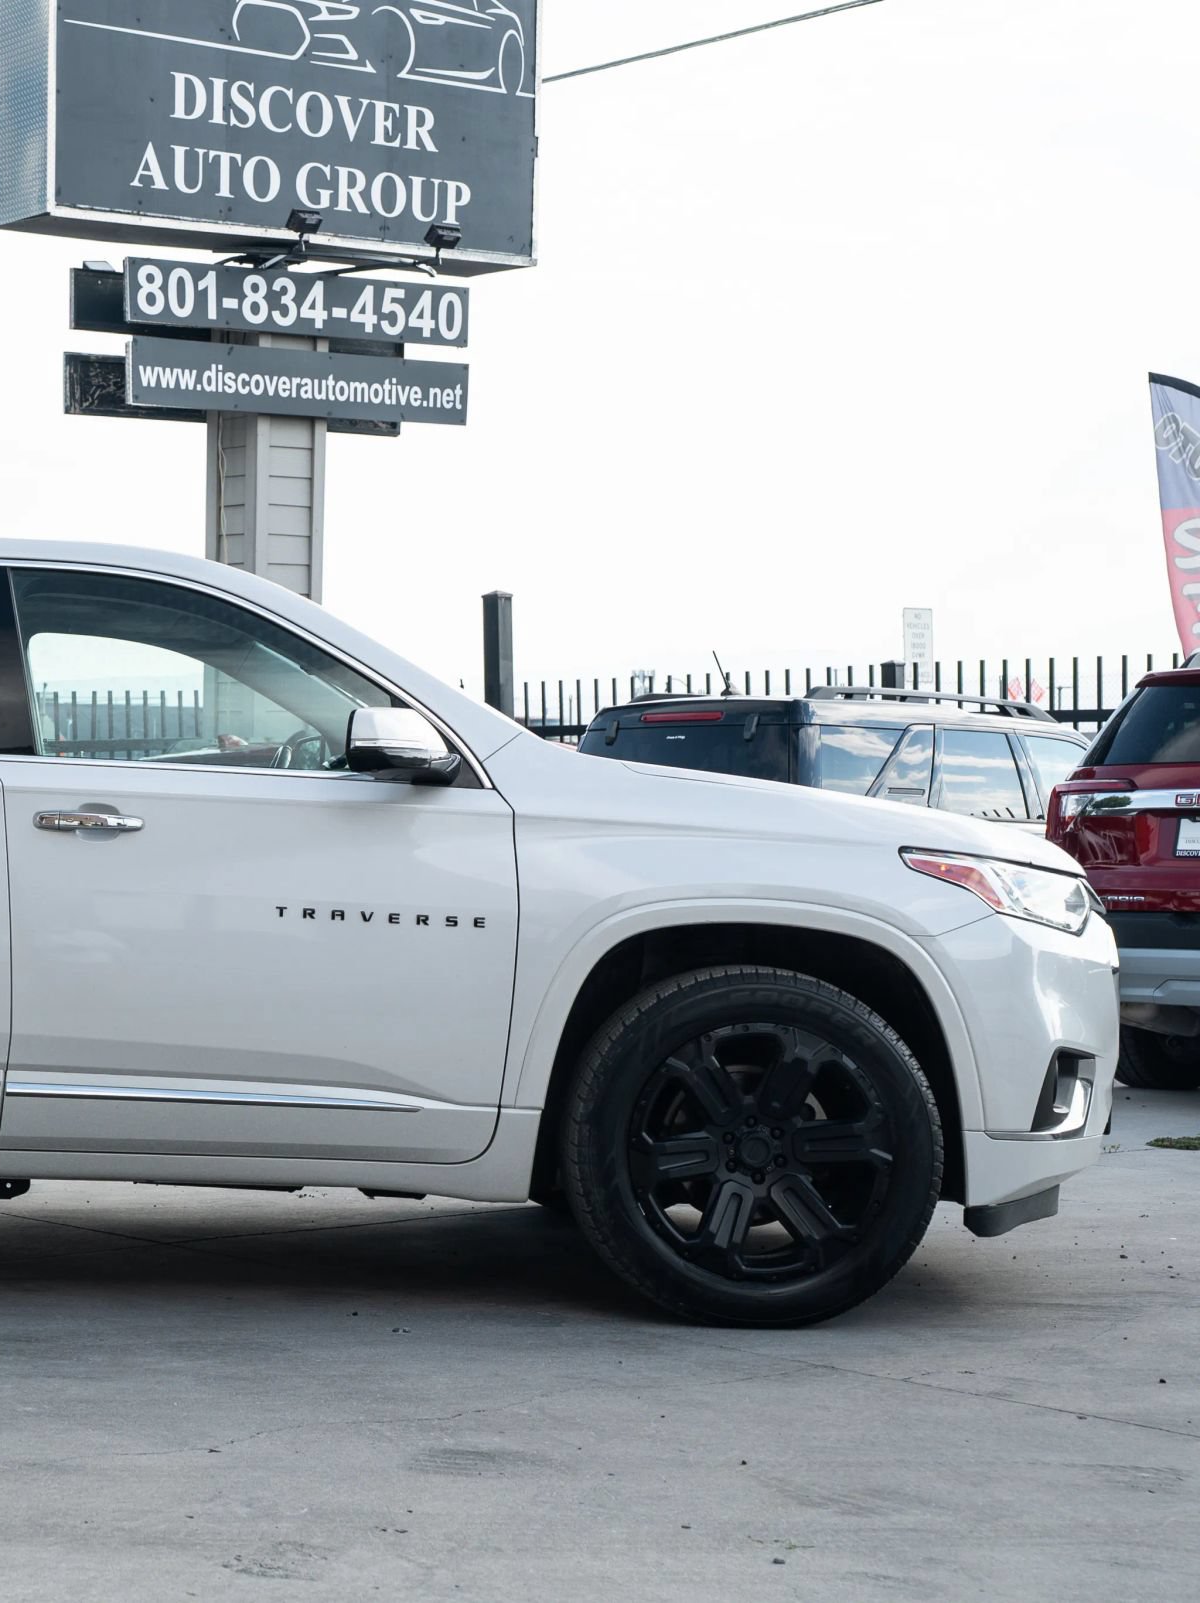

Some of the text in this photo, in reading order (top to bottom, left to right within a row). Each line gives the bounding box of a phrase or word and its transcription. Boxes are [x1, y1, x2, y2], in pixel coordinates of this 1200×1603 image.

[169, 71, 439, 153] DISCOVER
[130, 141, 472, 225] AUTO GROUP
[136, 264, 463, 341] 801-834-4540
[138, 363, 463, 410] www.discoverautomotive.net
[275, 906, 486, 928] TRAVERSE
